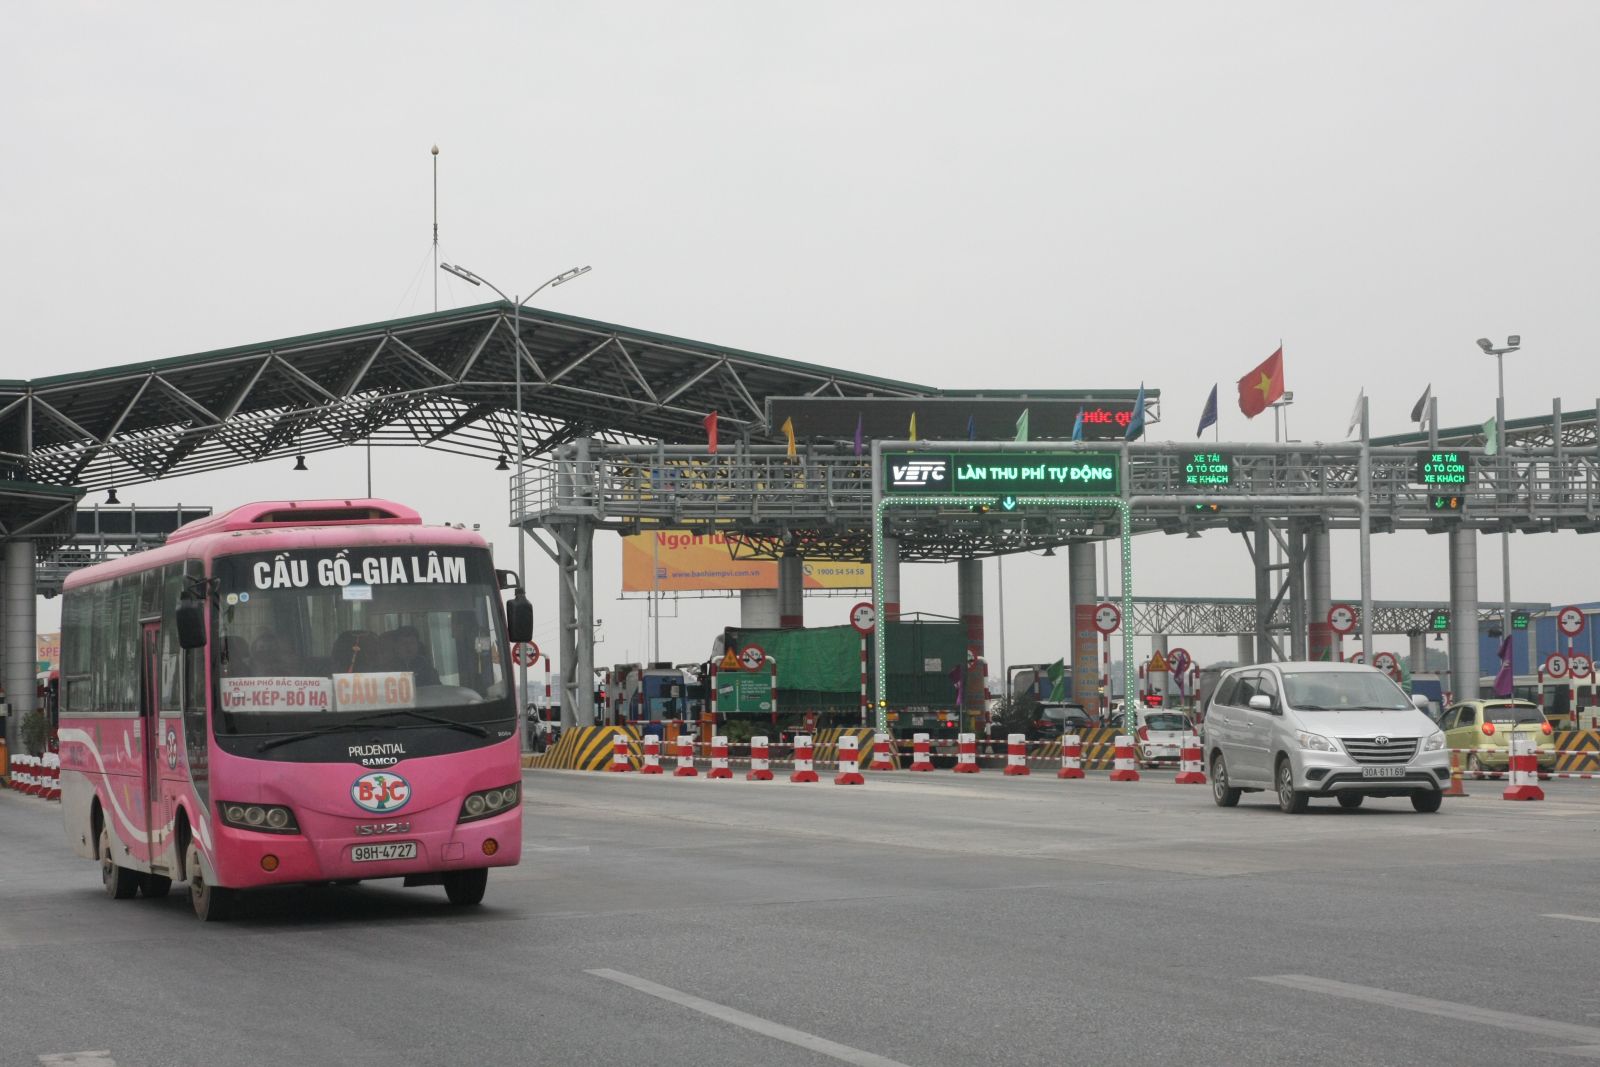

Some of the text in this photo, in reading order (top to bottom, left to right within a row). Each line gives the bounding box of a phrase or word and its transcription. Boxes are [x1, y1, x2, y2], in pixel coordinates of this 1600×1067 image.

[1194, 454, 1205, 462] XE
[1432, 454, 1442, 462] XE
[892, 463, 945, 483] VETC
[957, 464, 1112, 483] LÀN THU PHÍ TỰ ĐỘNG
[1424, 463, 1431, 472] Ô
[1433, 463, 1445, 472] TÔ
[1437, 473, 1465, 482] KHÁCH
[1450, 497, 1457, 508] 6
[656, 531, 703, 550] Ngọn
[253, 549, 467, 590] CẦU GỒ-GIA LÂM
[1553, 660, 1561, 672] 5
[228, 678, 255, 687] THÀNH
[276, 678, 292, 687] BẮC
[309, 691, 328, 709] HẠ
[348, 743, 406, 757] PRUDENTIAL
[362, 757, 398, 766] SAMCO
[359, 781, 406, 801] BJC
[355, 822, 411, 836] ISUZU
[355, 844, 413, 860] 98H-4727
